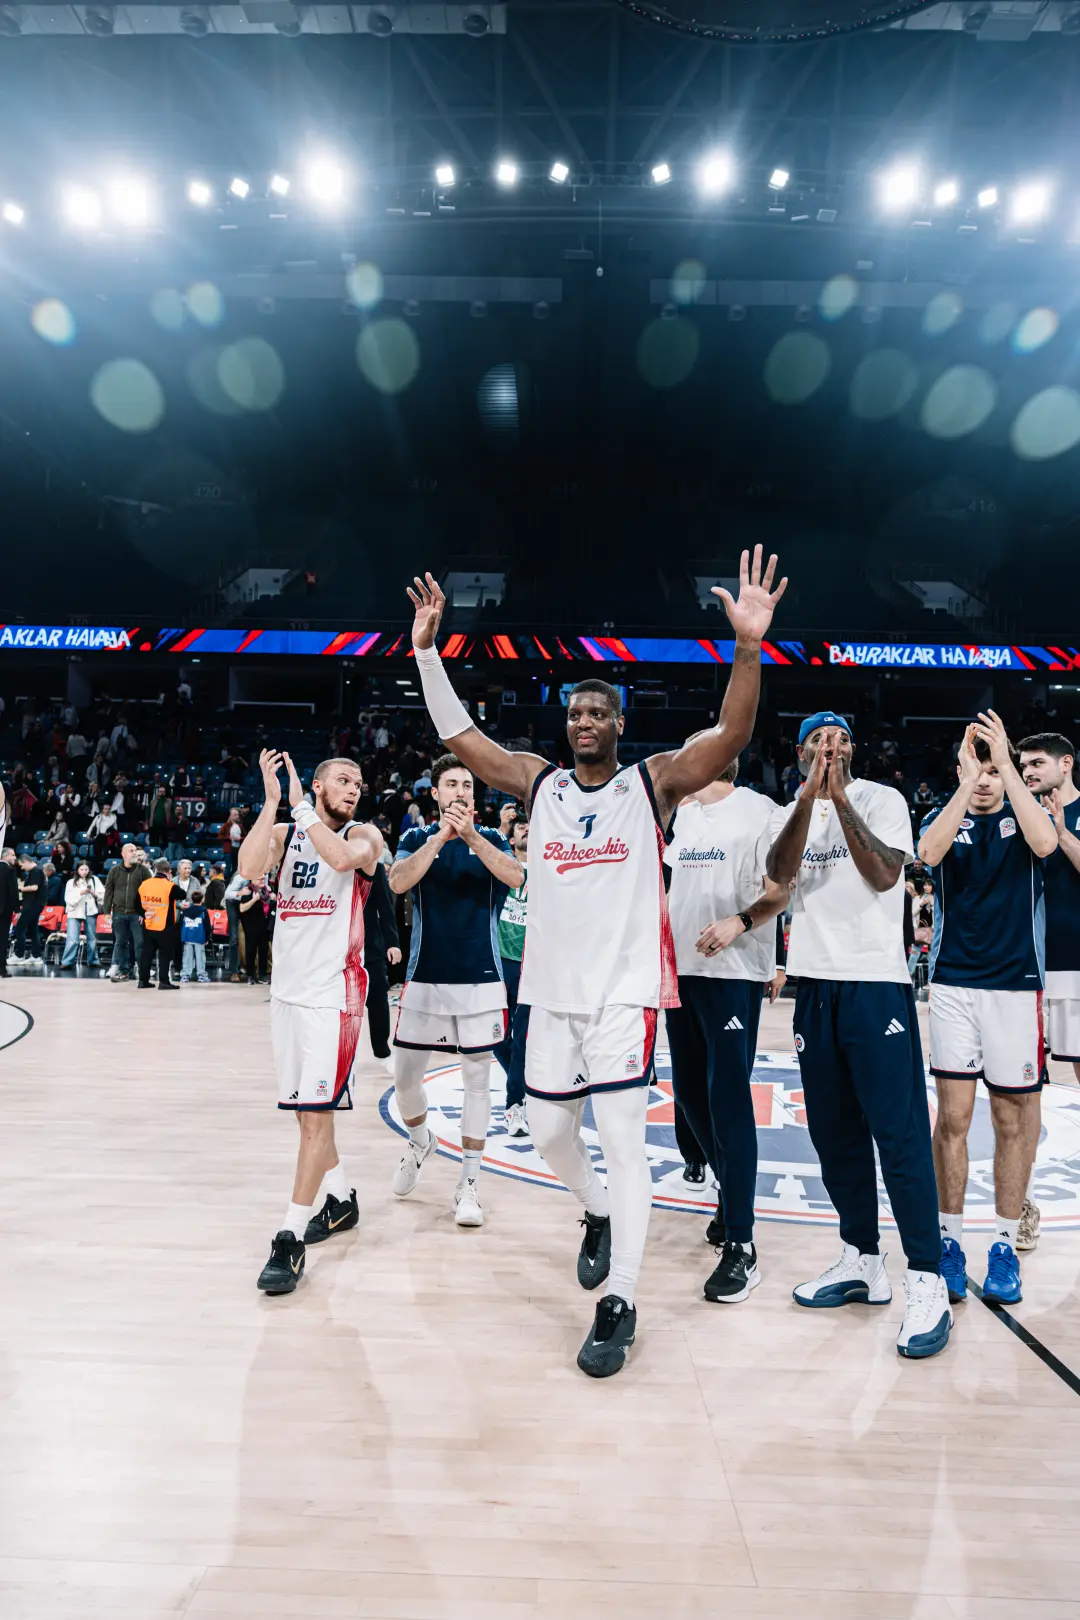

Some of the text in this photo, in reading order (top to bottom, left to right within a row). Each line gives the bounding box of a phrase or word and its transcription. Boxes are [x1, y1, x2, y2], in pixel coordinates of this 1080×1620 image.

[65, 628, 131, 649] HAVAYA
[829, 645, 1012, 668] BAYRAKLAR HAVAYA
[578, 814, 597, 839] 7
[291, 860, 320, 889] 22
